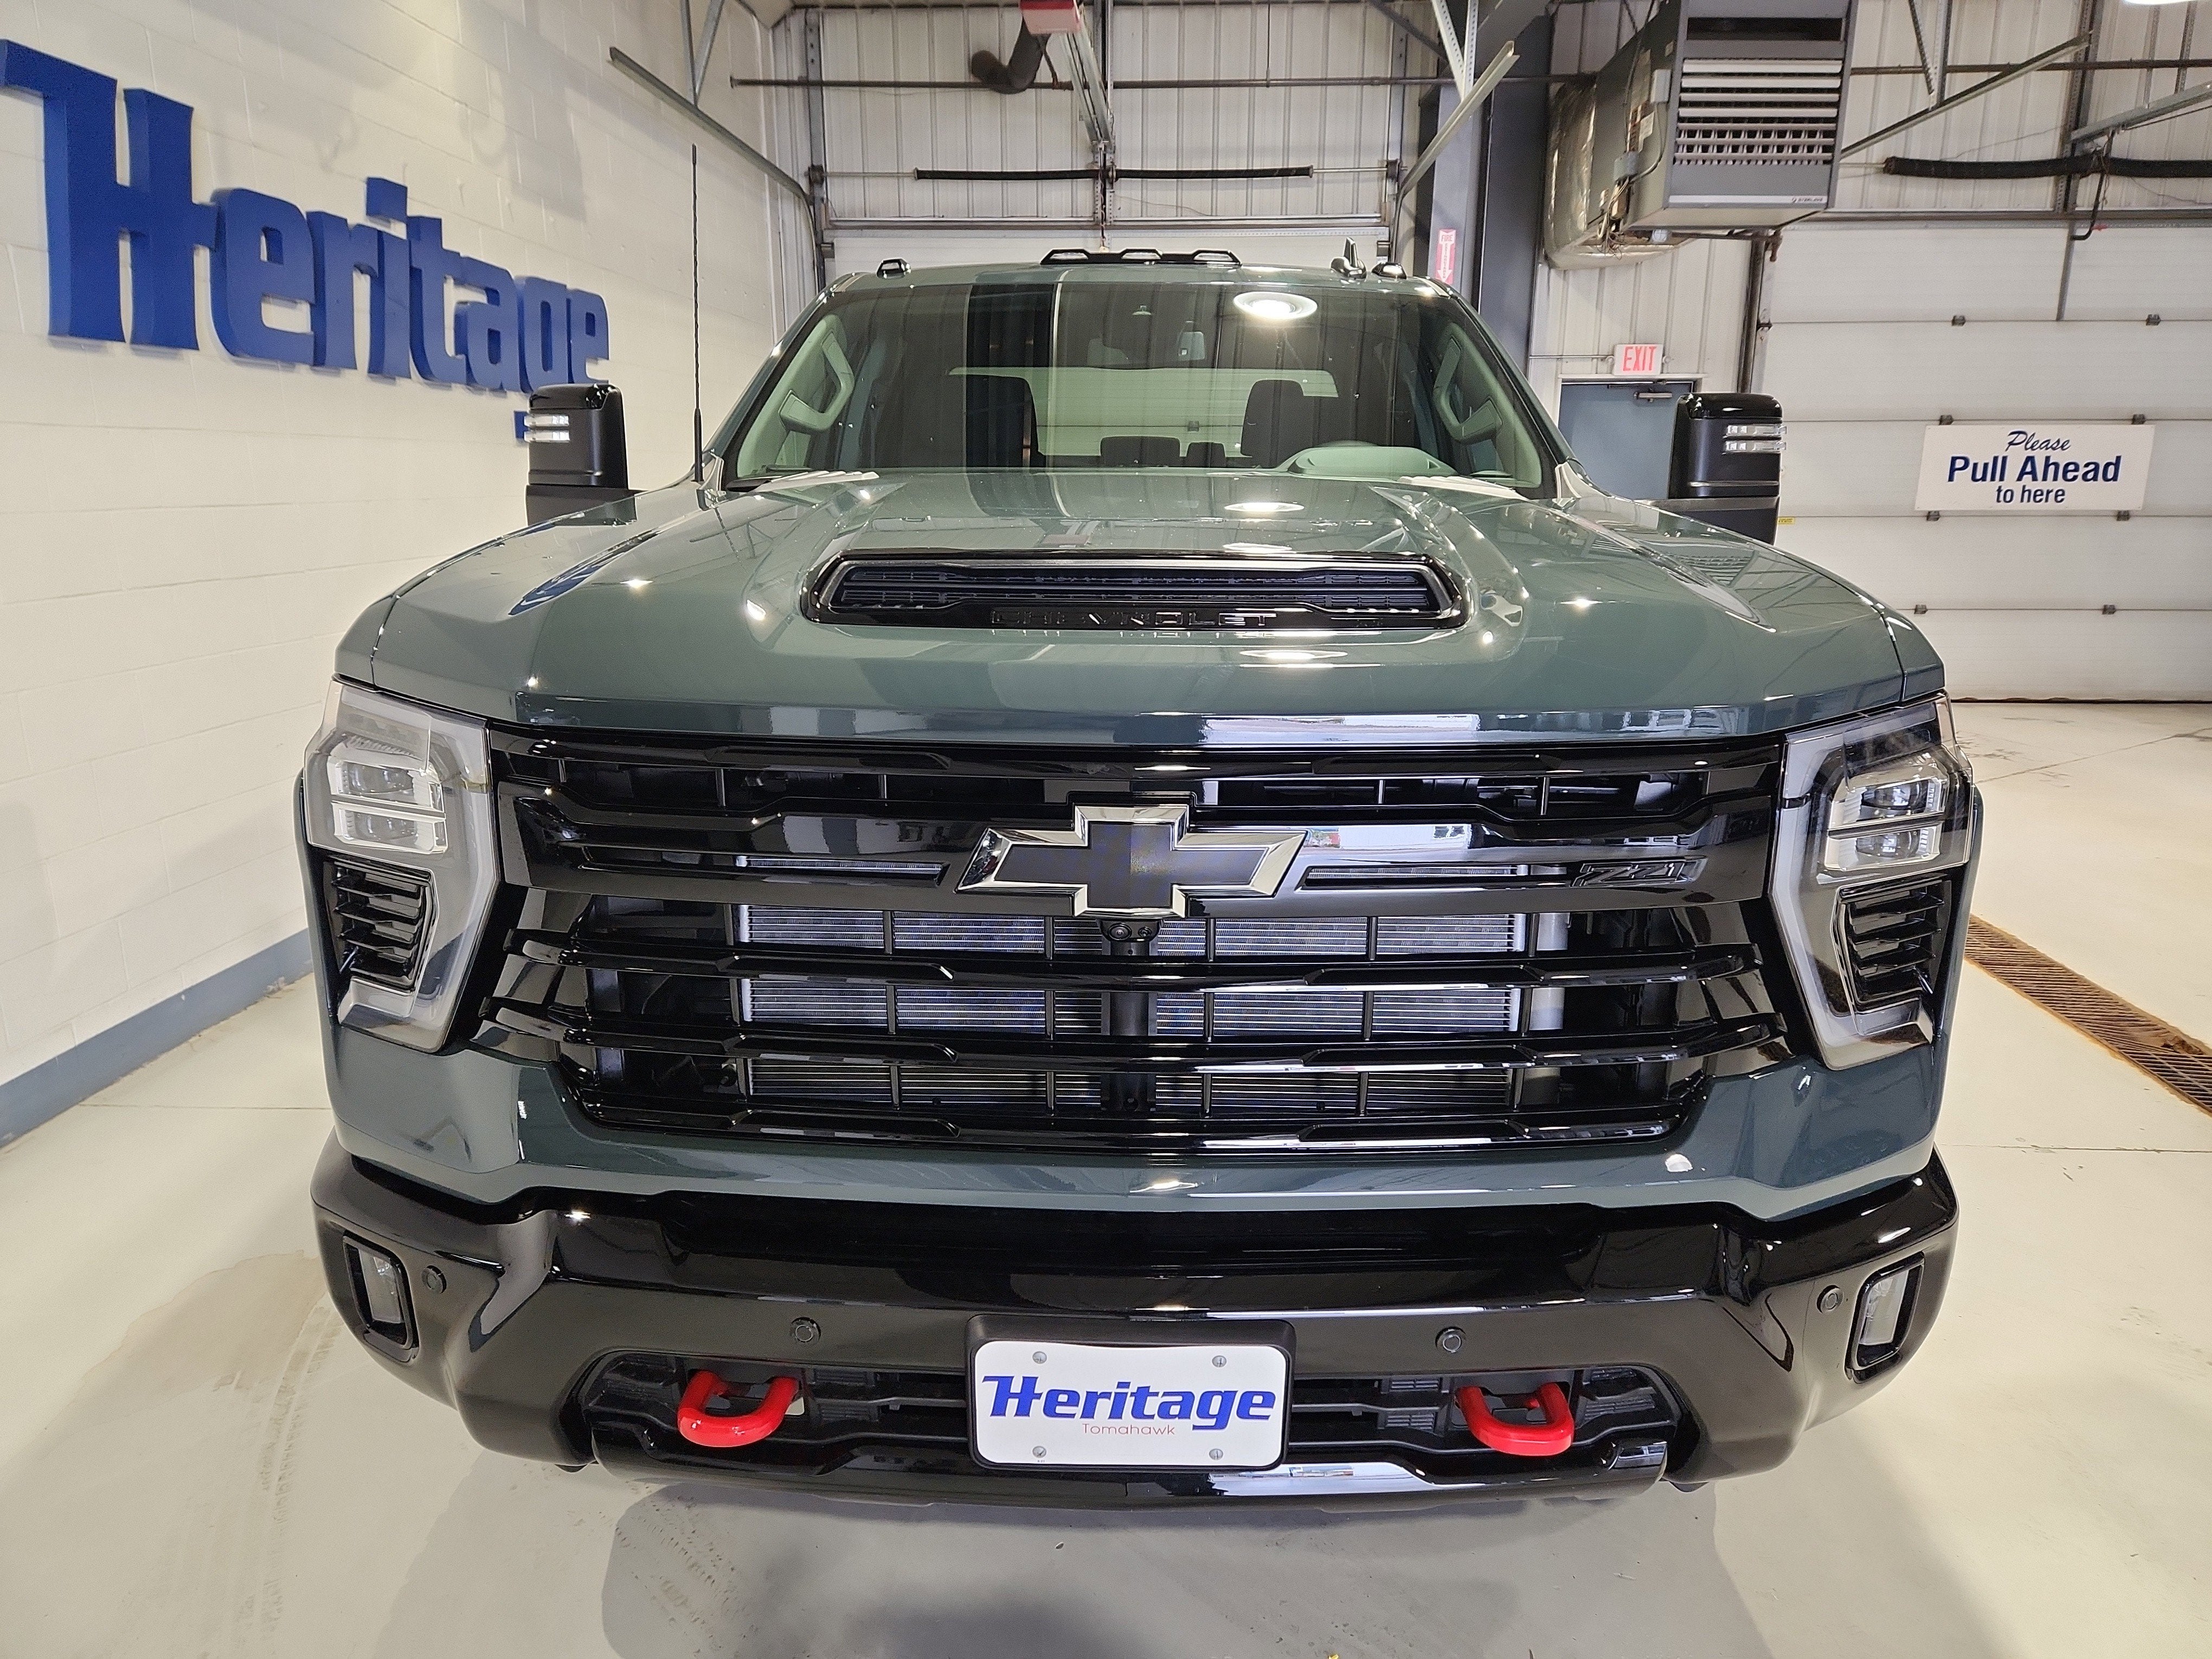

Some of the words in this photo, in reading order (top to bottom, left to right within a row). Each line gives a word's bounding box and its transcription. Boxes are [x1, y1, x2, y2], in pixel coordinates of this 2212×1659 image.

[0, 39, 609, 438] Heritage
[1623, 346, 1657, 371] EXIT
[2006, 430, 2071, 451] Please
[1948, 455, 2008, 483] Pull
[2016, 455, 2122, 483] Ahead
[1996, 485, 2015, 503] to
[2020, 485, 2066, 503] here
[991, 611, 1277, 626] CHEVROLET
[1572, 859, 1686, 887] Z71
[982, 1375, 1276, 1431] Heritage
[1082, 1423, 1175, 1436] Tomahawk
